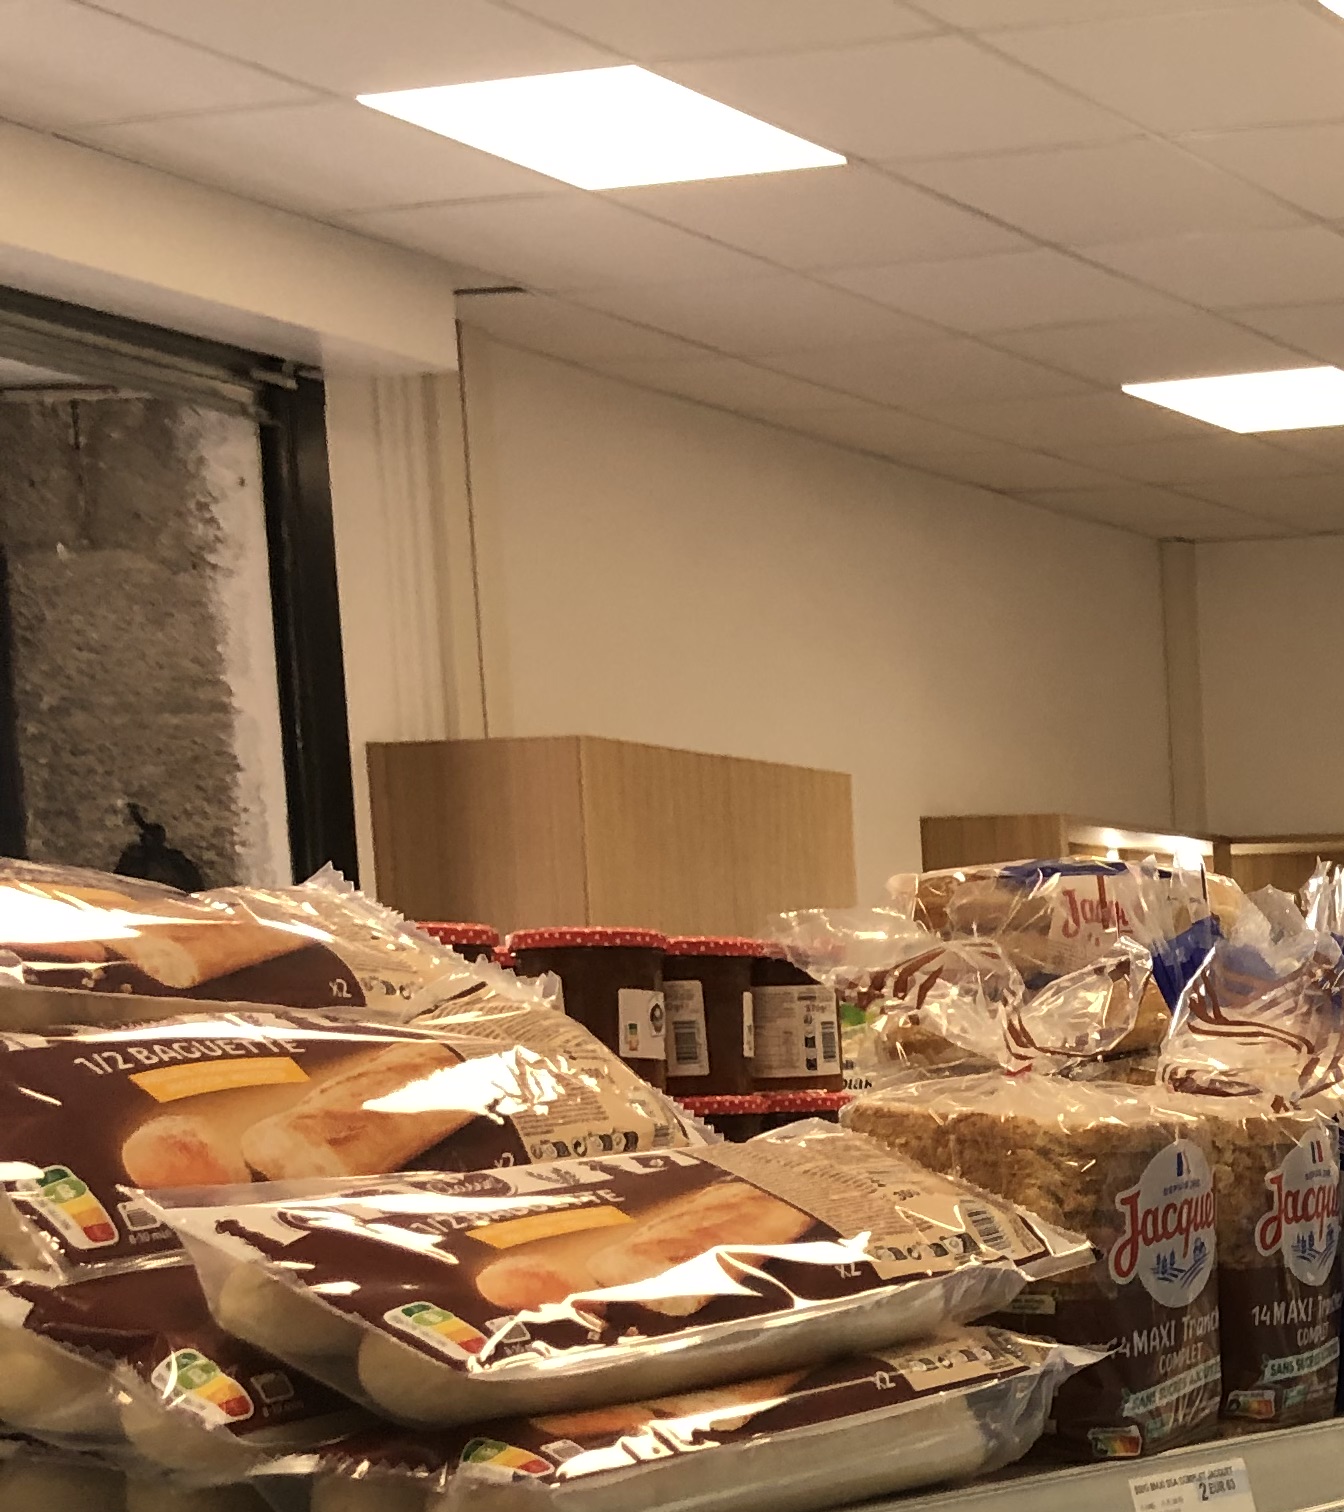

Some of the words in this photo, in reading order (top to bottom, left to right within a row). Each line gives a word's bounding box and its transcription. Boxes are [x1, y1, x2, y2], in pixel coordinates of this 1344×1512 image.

[1114, 1189, 1216, 1278] Jacque
[1260, 1172, 1340, 1251] Jacqu
[1158, 1341, 1204, 1375] COMPLET
[1198, 1481, 1209, 1502] 2
[1208, 1480, 1226, 1495] EUR
